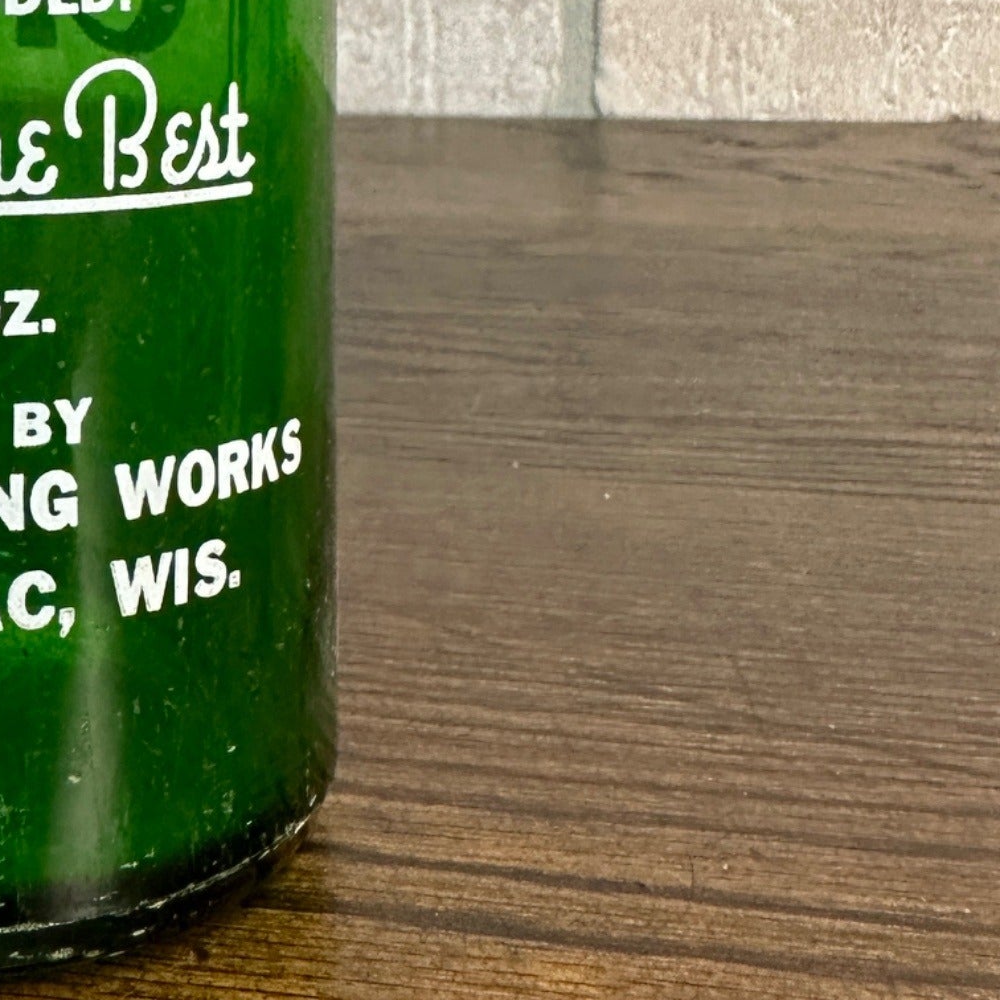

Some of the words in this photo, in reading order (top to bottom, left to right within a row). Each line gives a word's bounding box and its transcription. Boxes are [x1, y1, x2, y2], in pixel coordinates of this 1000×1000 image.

[63, 58, 257, 193] Best
[14, 397, 92, 448] BY
[115, 418, 301, 520] WORKS
[110, 539, 240, 616] WIS.
